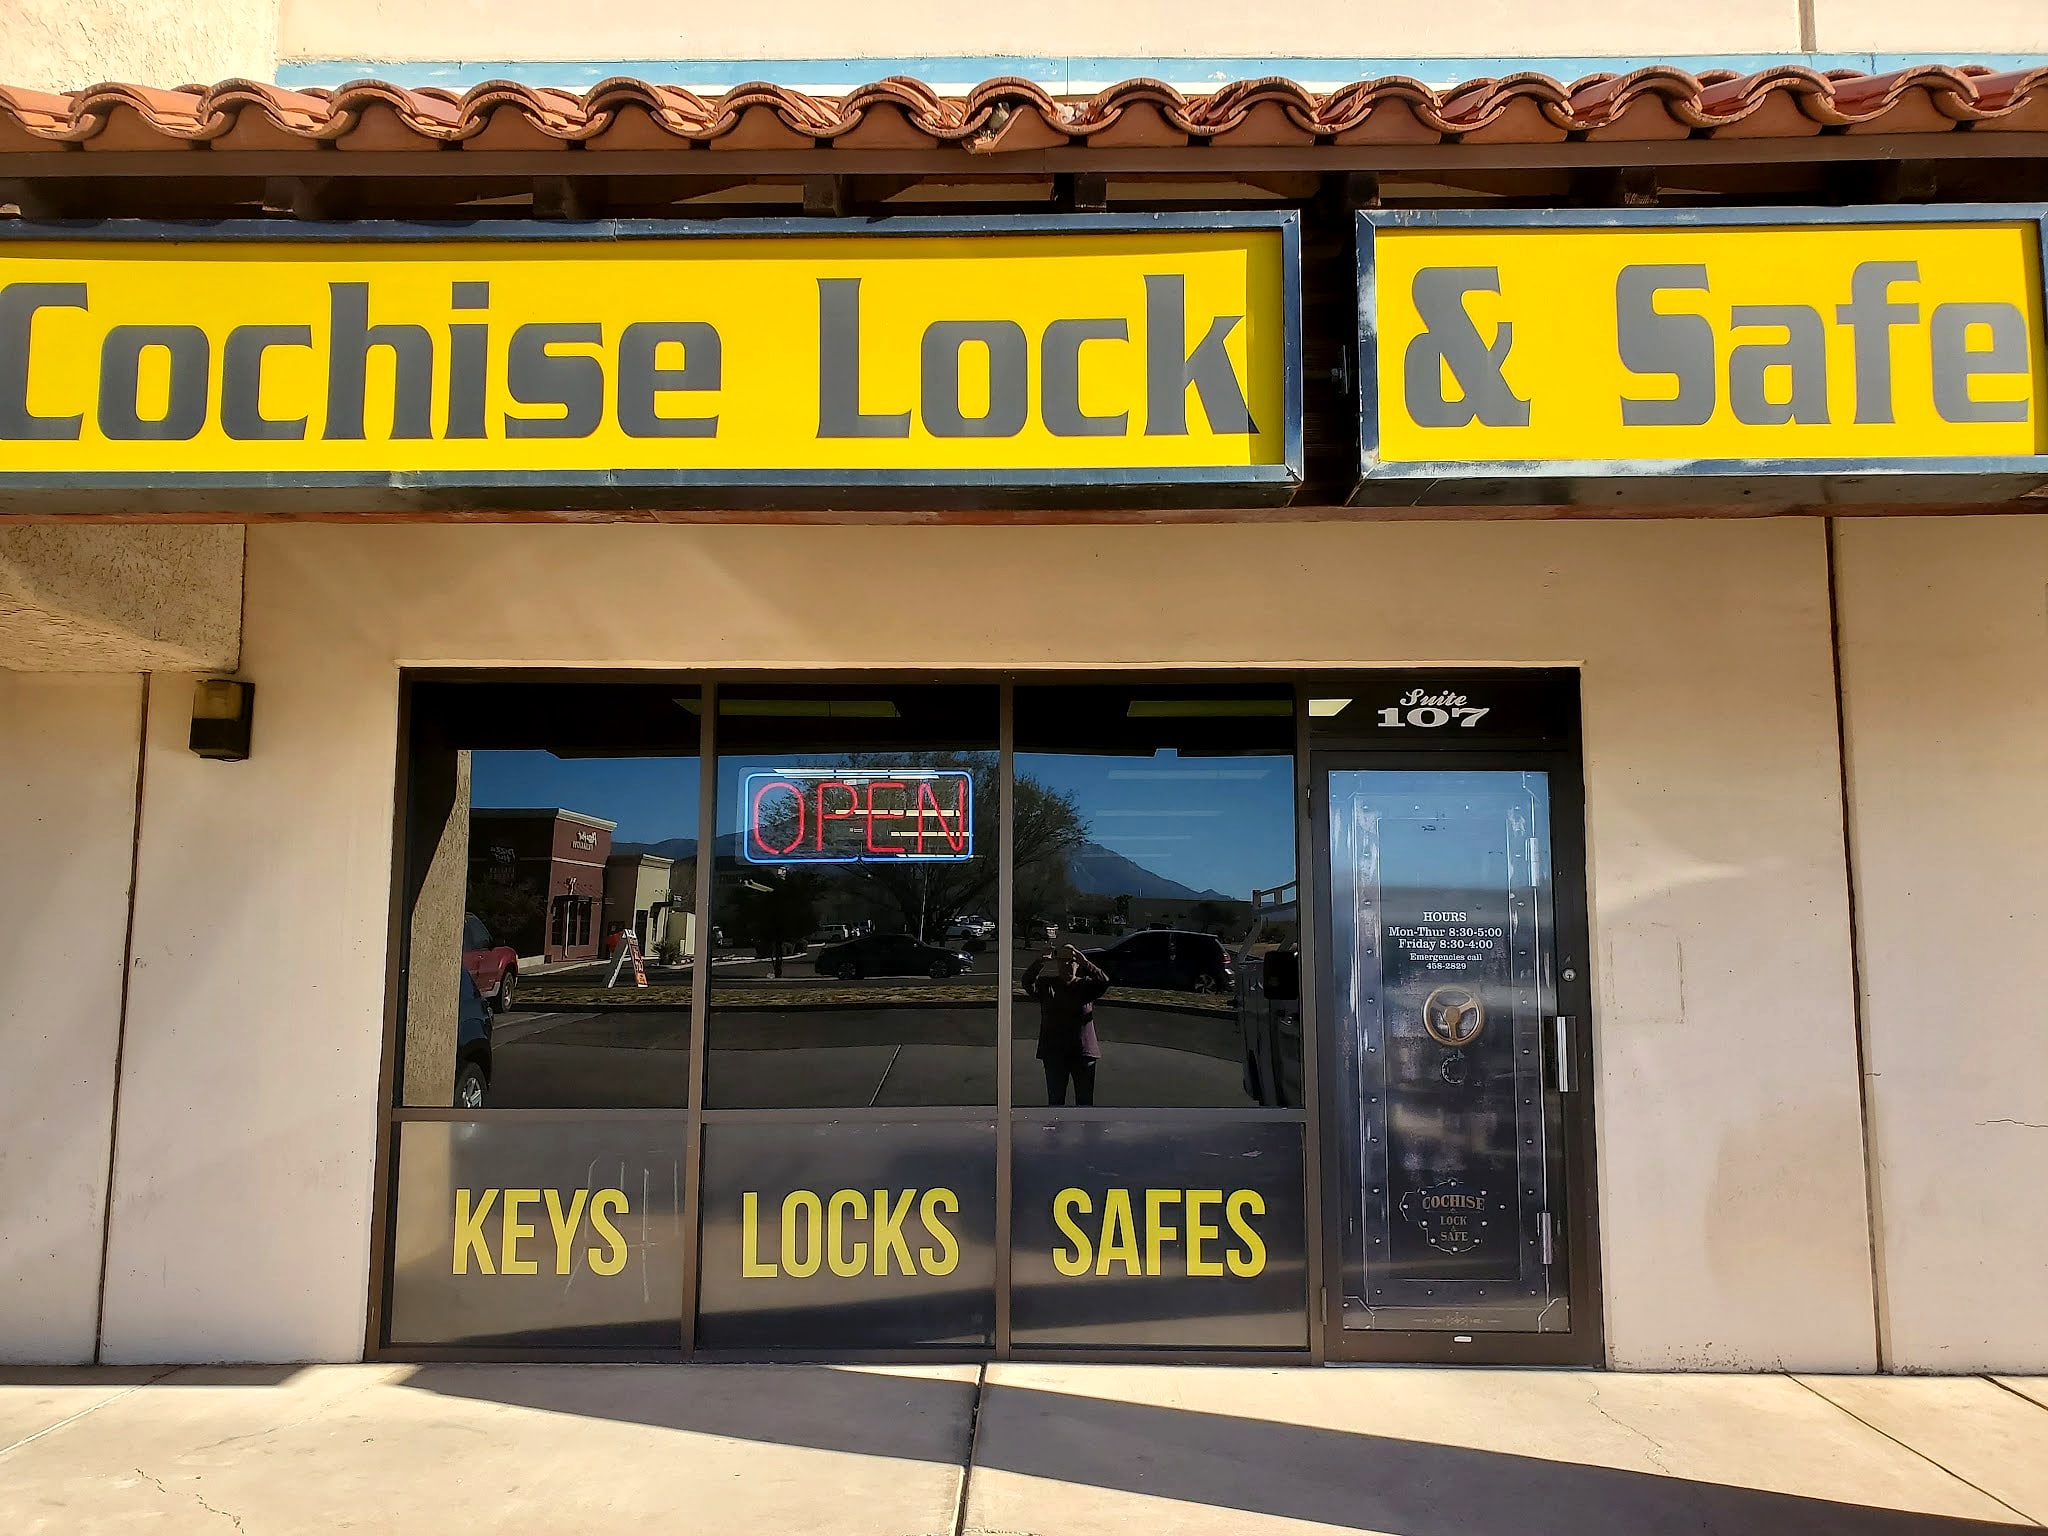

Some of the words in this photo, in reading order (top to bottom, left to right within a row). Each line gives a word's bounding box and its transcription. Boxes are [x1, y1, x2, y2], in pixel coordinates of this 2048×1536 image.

[0, 281, 722, 441] Cochise
[816, 273, 1260, 439] Lock
[1403, 265, 1532, 428] &
[1615, 260, 2030, 427] Safe
[1399, 688, 1468, 706] Suite
[1377, 707, 1490, 728] 107
[754, 780, 966, 854] OPEN
[1422, 911, 1467, 922] HOURS
[1388, 927, 1445, 937] Mon-Thur
[1448, 927, 1503, 938] 8:30-5:00
[1398, 938, 1436, 951] Friday
[1439, 938, 1493, 949] 8:30-4:00
[1409, 952, 1465, 962] Emergencies
[1466, 952, 1483, 961] call
[1425, 962, 1467, 970] 458-2829
[1422, 1194, 1485, 1210] COCHISE
[1440, 1215, 1468, 1226] LOCK
[451, 1187, 629, 1277] KEYS
[742, 1187, 961, 1279] LOCKS
[1051, 1187, 1268, 1278] SAFES
[1440, 1231, 1468, 1242] SAFE
